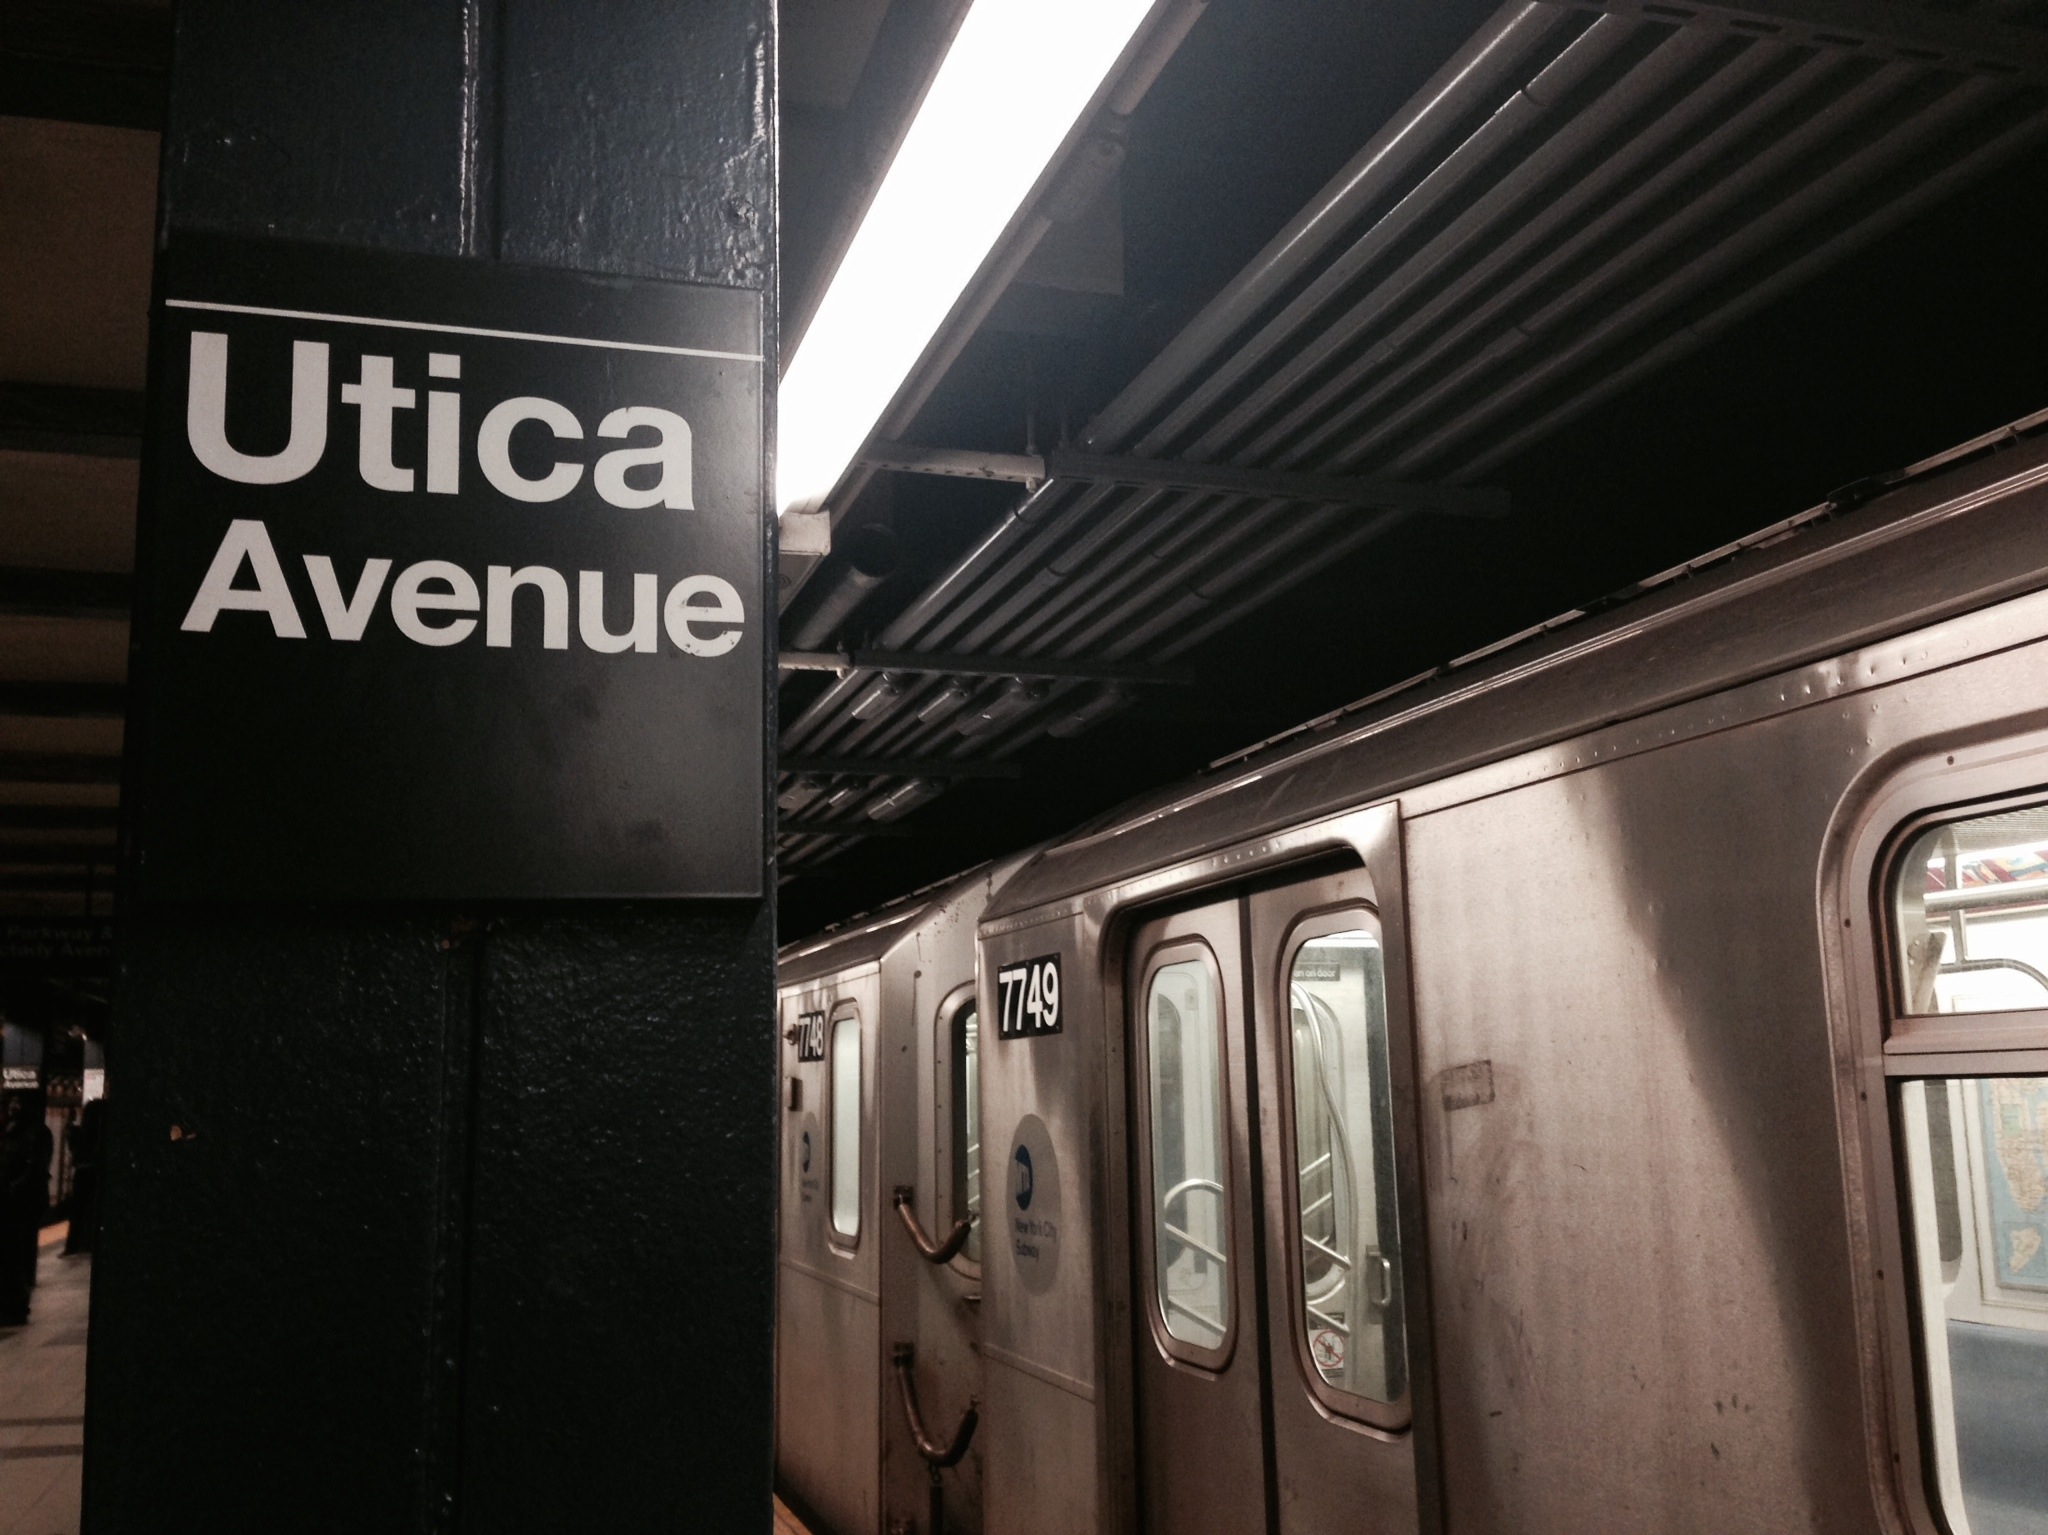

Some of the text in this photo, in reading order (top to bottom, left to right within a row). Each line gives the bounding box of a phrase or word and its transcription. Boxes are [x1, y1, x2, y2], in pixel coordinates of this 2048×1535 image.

[187, 330, 695, 511] Utica
[180, 519, 745, 658] Avenue
[798, 1015, 824, 1057] 7748
[999, 962, 1059, 1032] 7749
